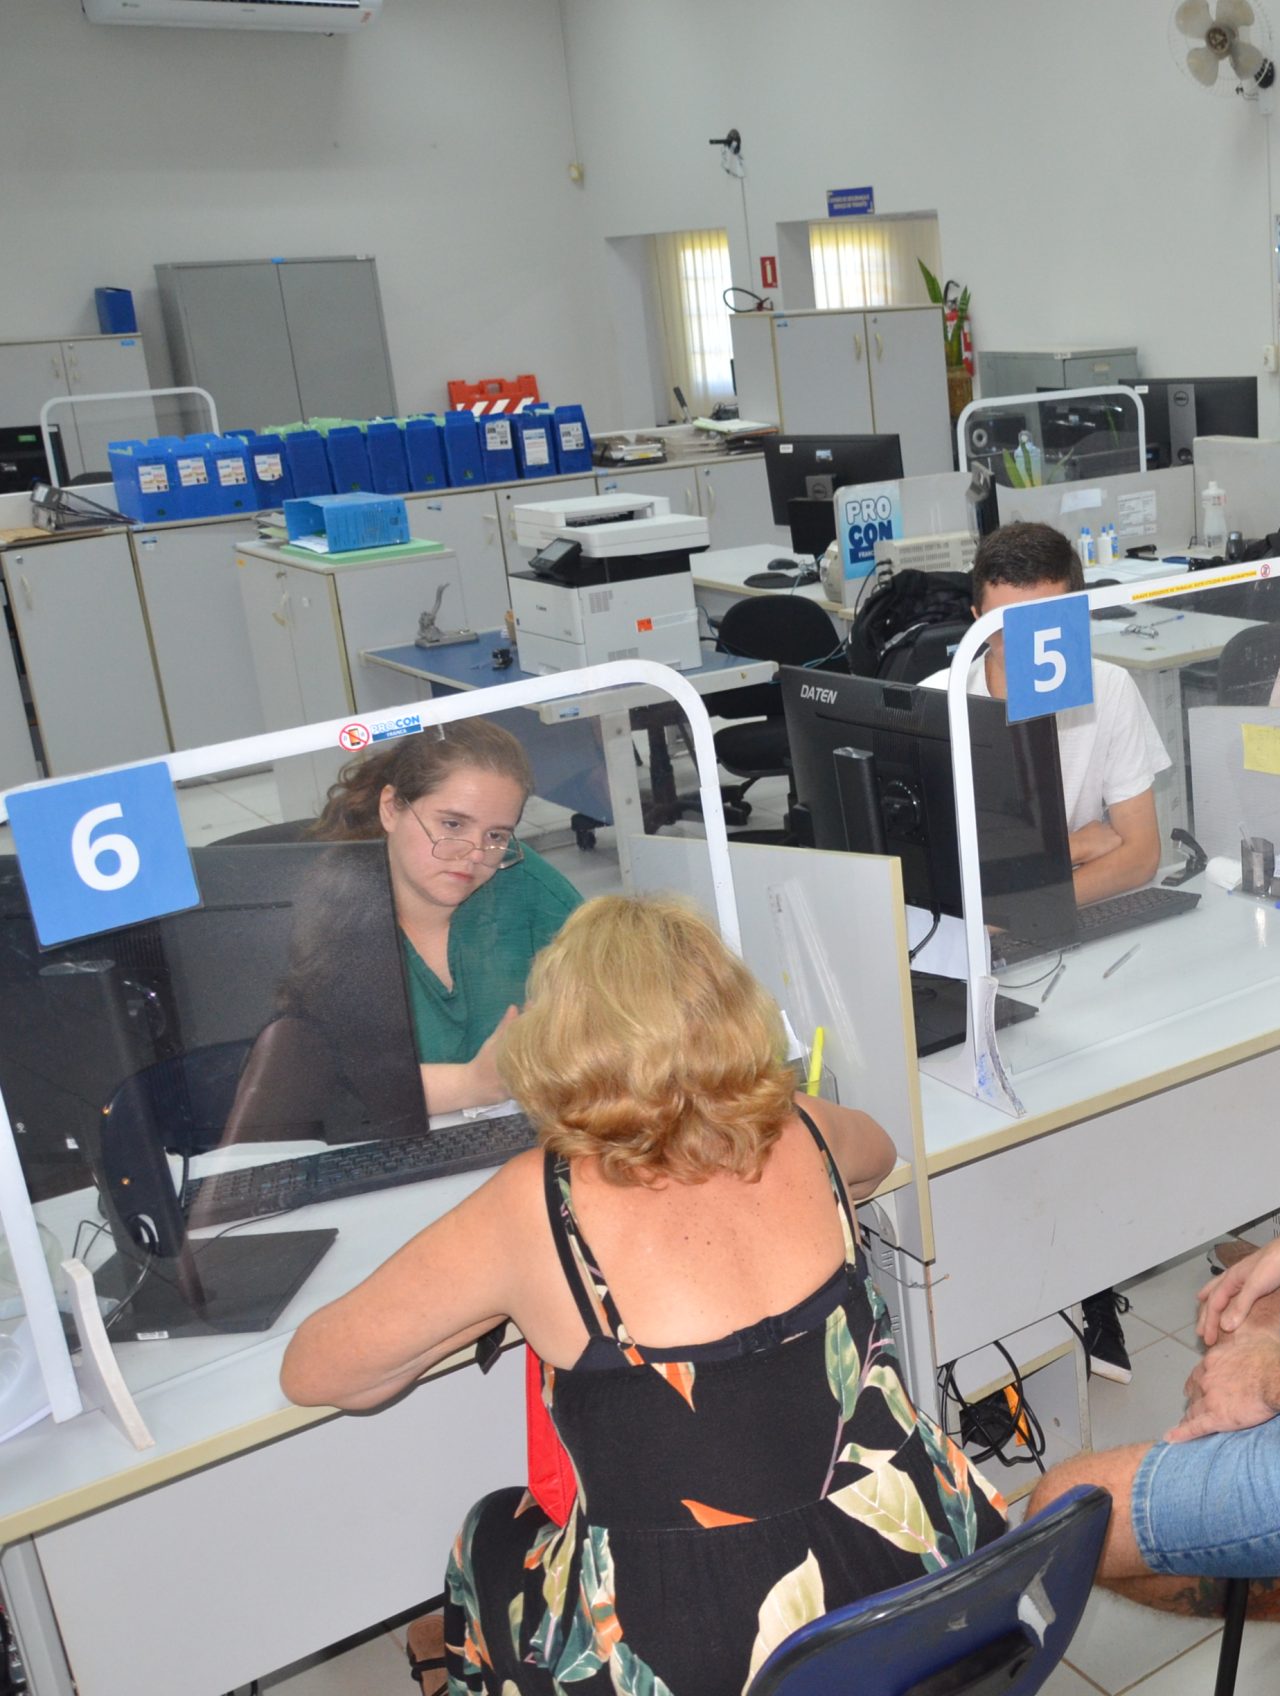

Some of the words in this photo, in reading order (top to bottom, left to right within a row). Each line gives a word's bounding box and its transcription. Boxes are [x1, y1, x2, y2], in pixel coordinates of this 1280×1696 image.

[845, 496, 891, 525] PRO
[848, 520, 893, 549] CON
[1033, 626, 1066, 693] 5
[800, 684, 838, 705] DATEN
[71, 802, 140, 891] 6
